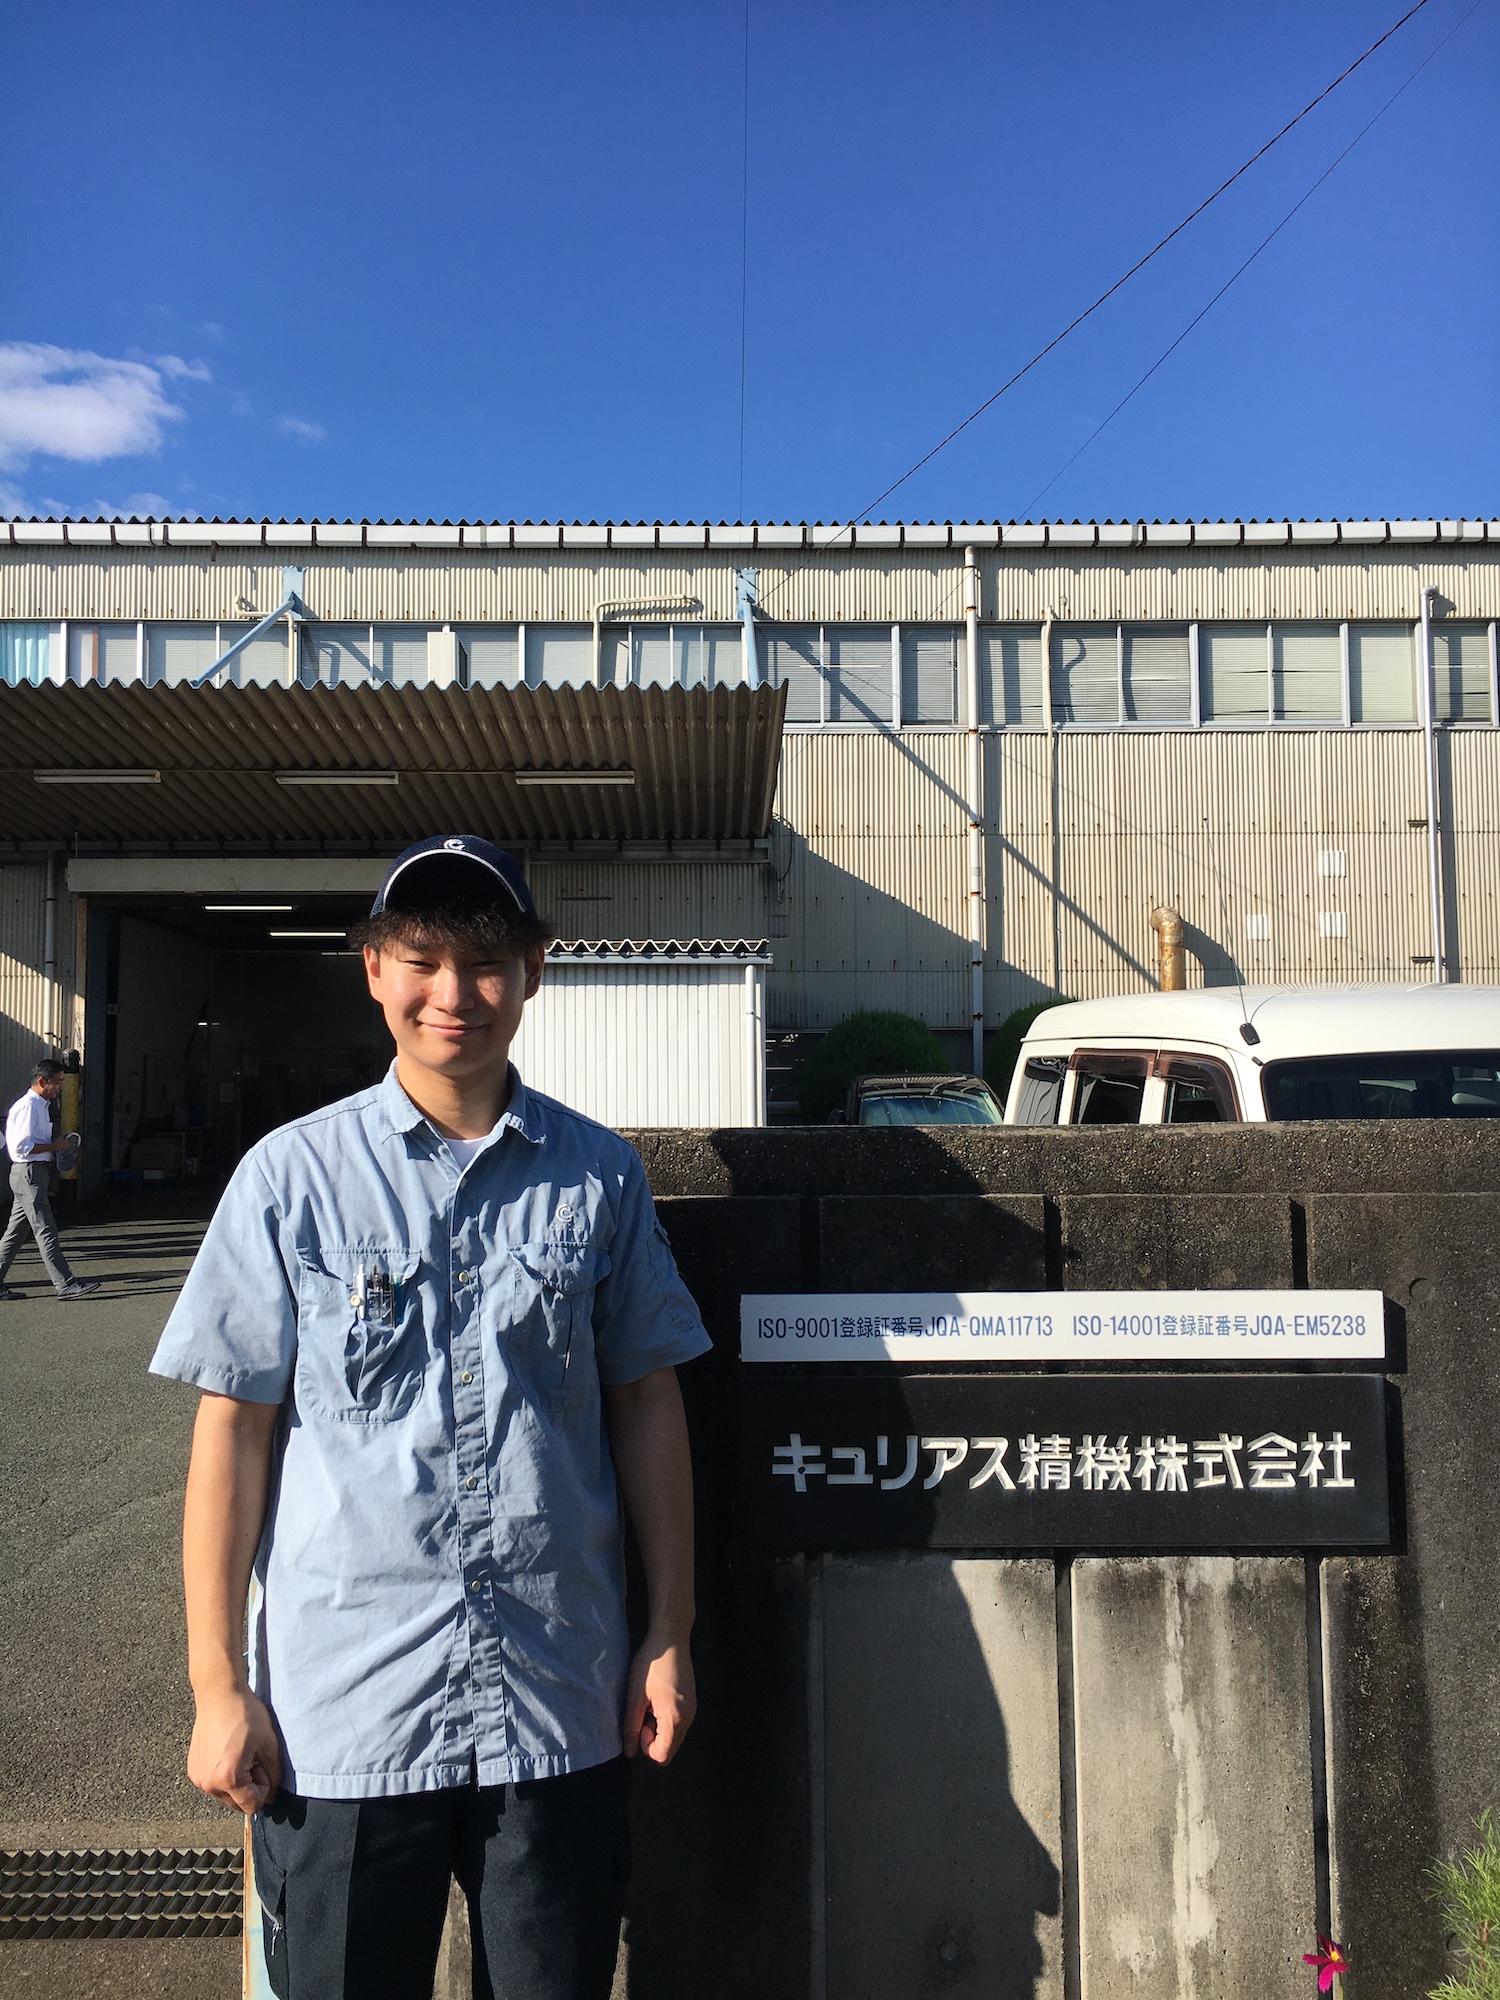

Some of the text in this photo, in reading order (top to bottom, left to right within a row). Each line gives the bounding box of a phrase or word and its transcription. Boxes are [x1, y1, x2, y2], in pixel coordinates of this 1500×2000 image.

[758, 1315, 1366, 1338] ISO-9001登録証番号JQA-QMA11713 ISO-14001登録証番号JQA-EM5238
[771, 1432, 1356, 1492] キュリアス精機株式会社
